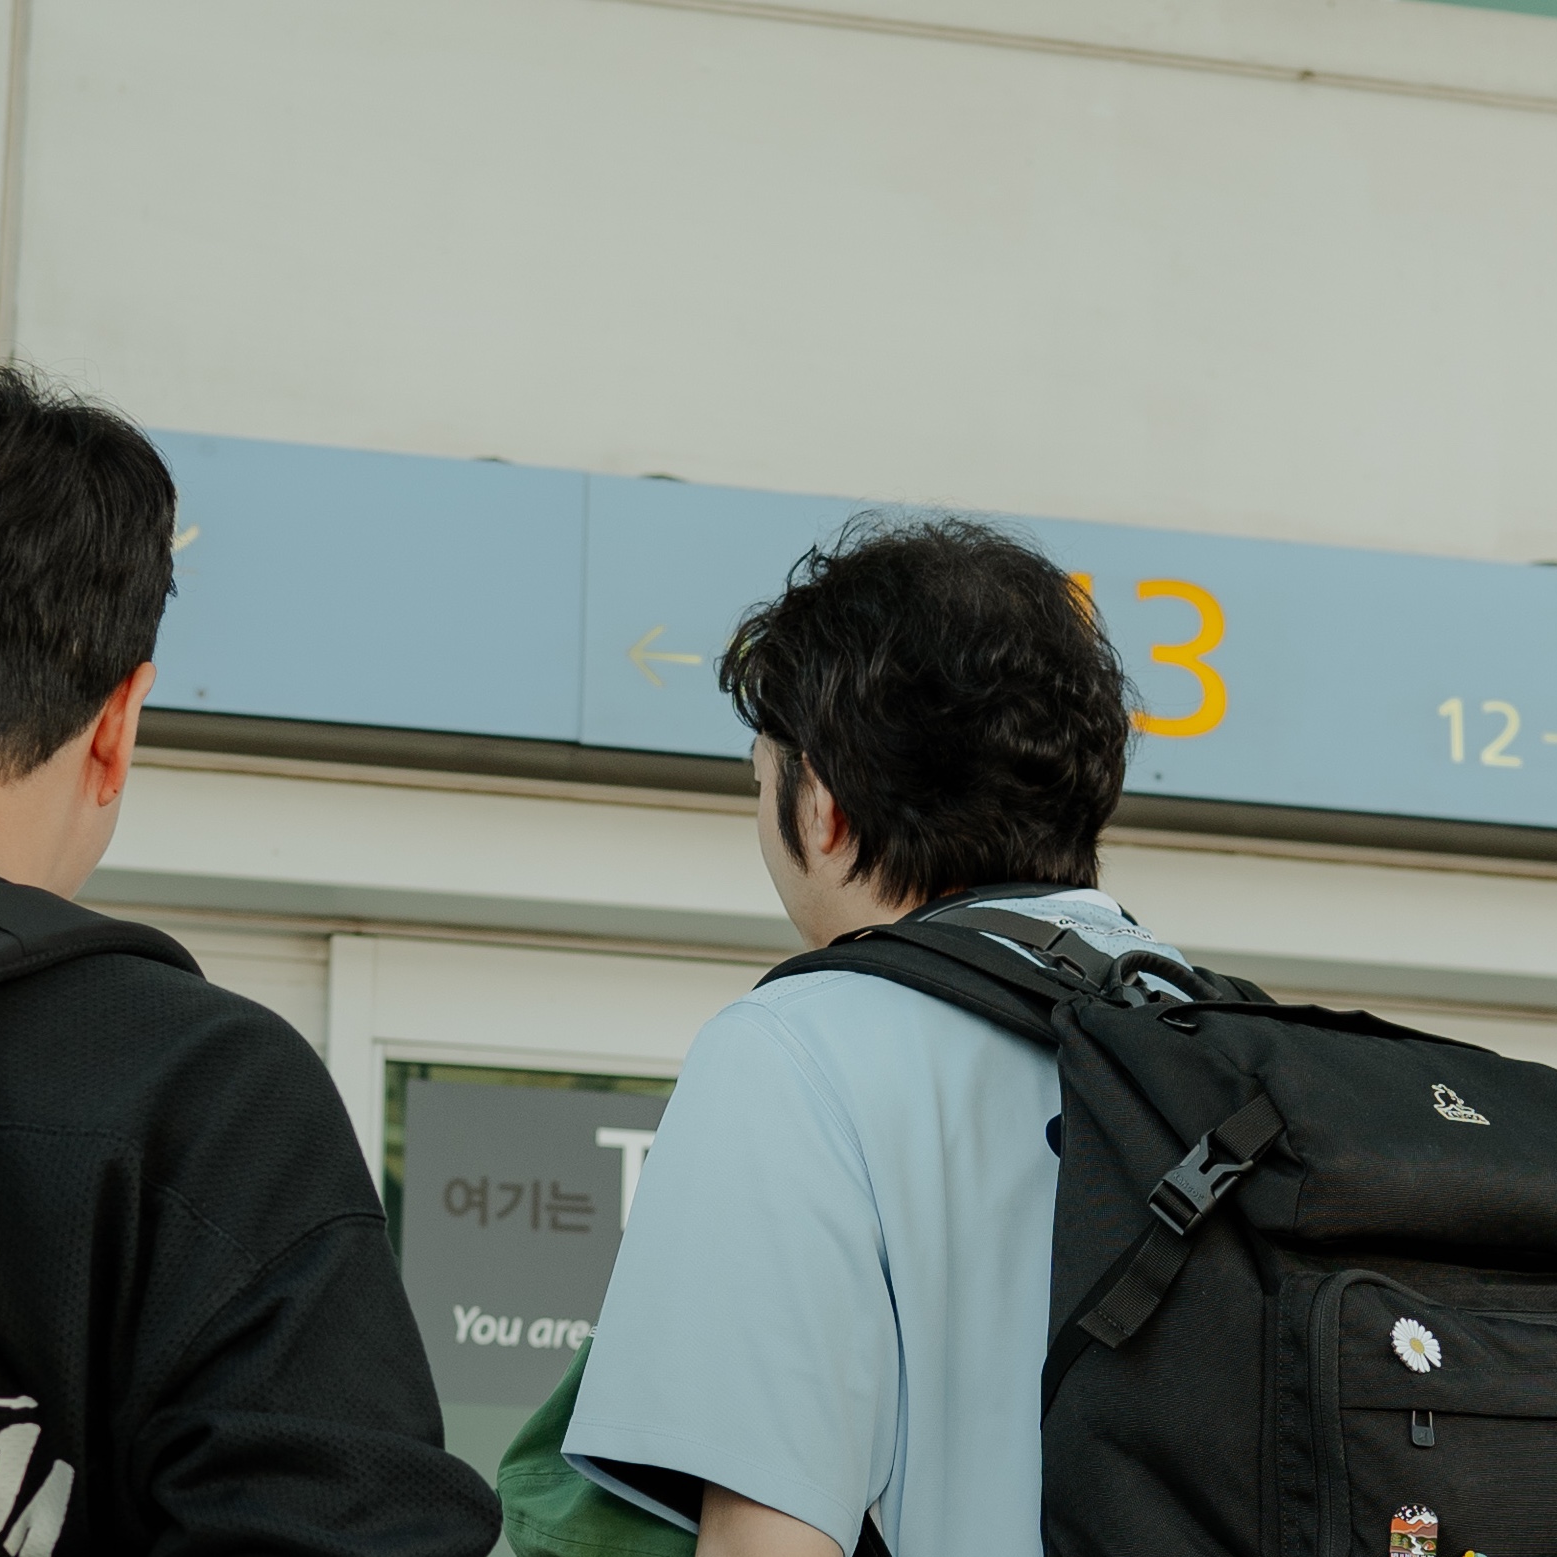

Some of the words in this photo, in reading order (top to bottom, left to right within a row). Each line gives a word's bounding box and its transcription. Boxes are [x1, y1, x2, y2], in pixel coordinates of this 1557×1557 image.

[1065, 573, 1228, 738] 3
[1438, 698, 1525, 770] 12
[443, 1176, 597, 1234] 여기는
[595, 1127, 657, 1231] T
[453, 1305, 522, 1347] You
[527, 1317, 591, 1351] are
